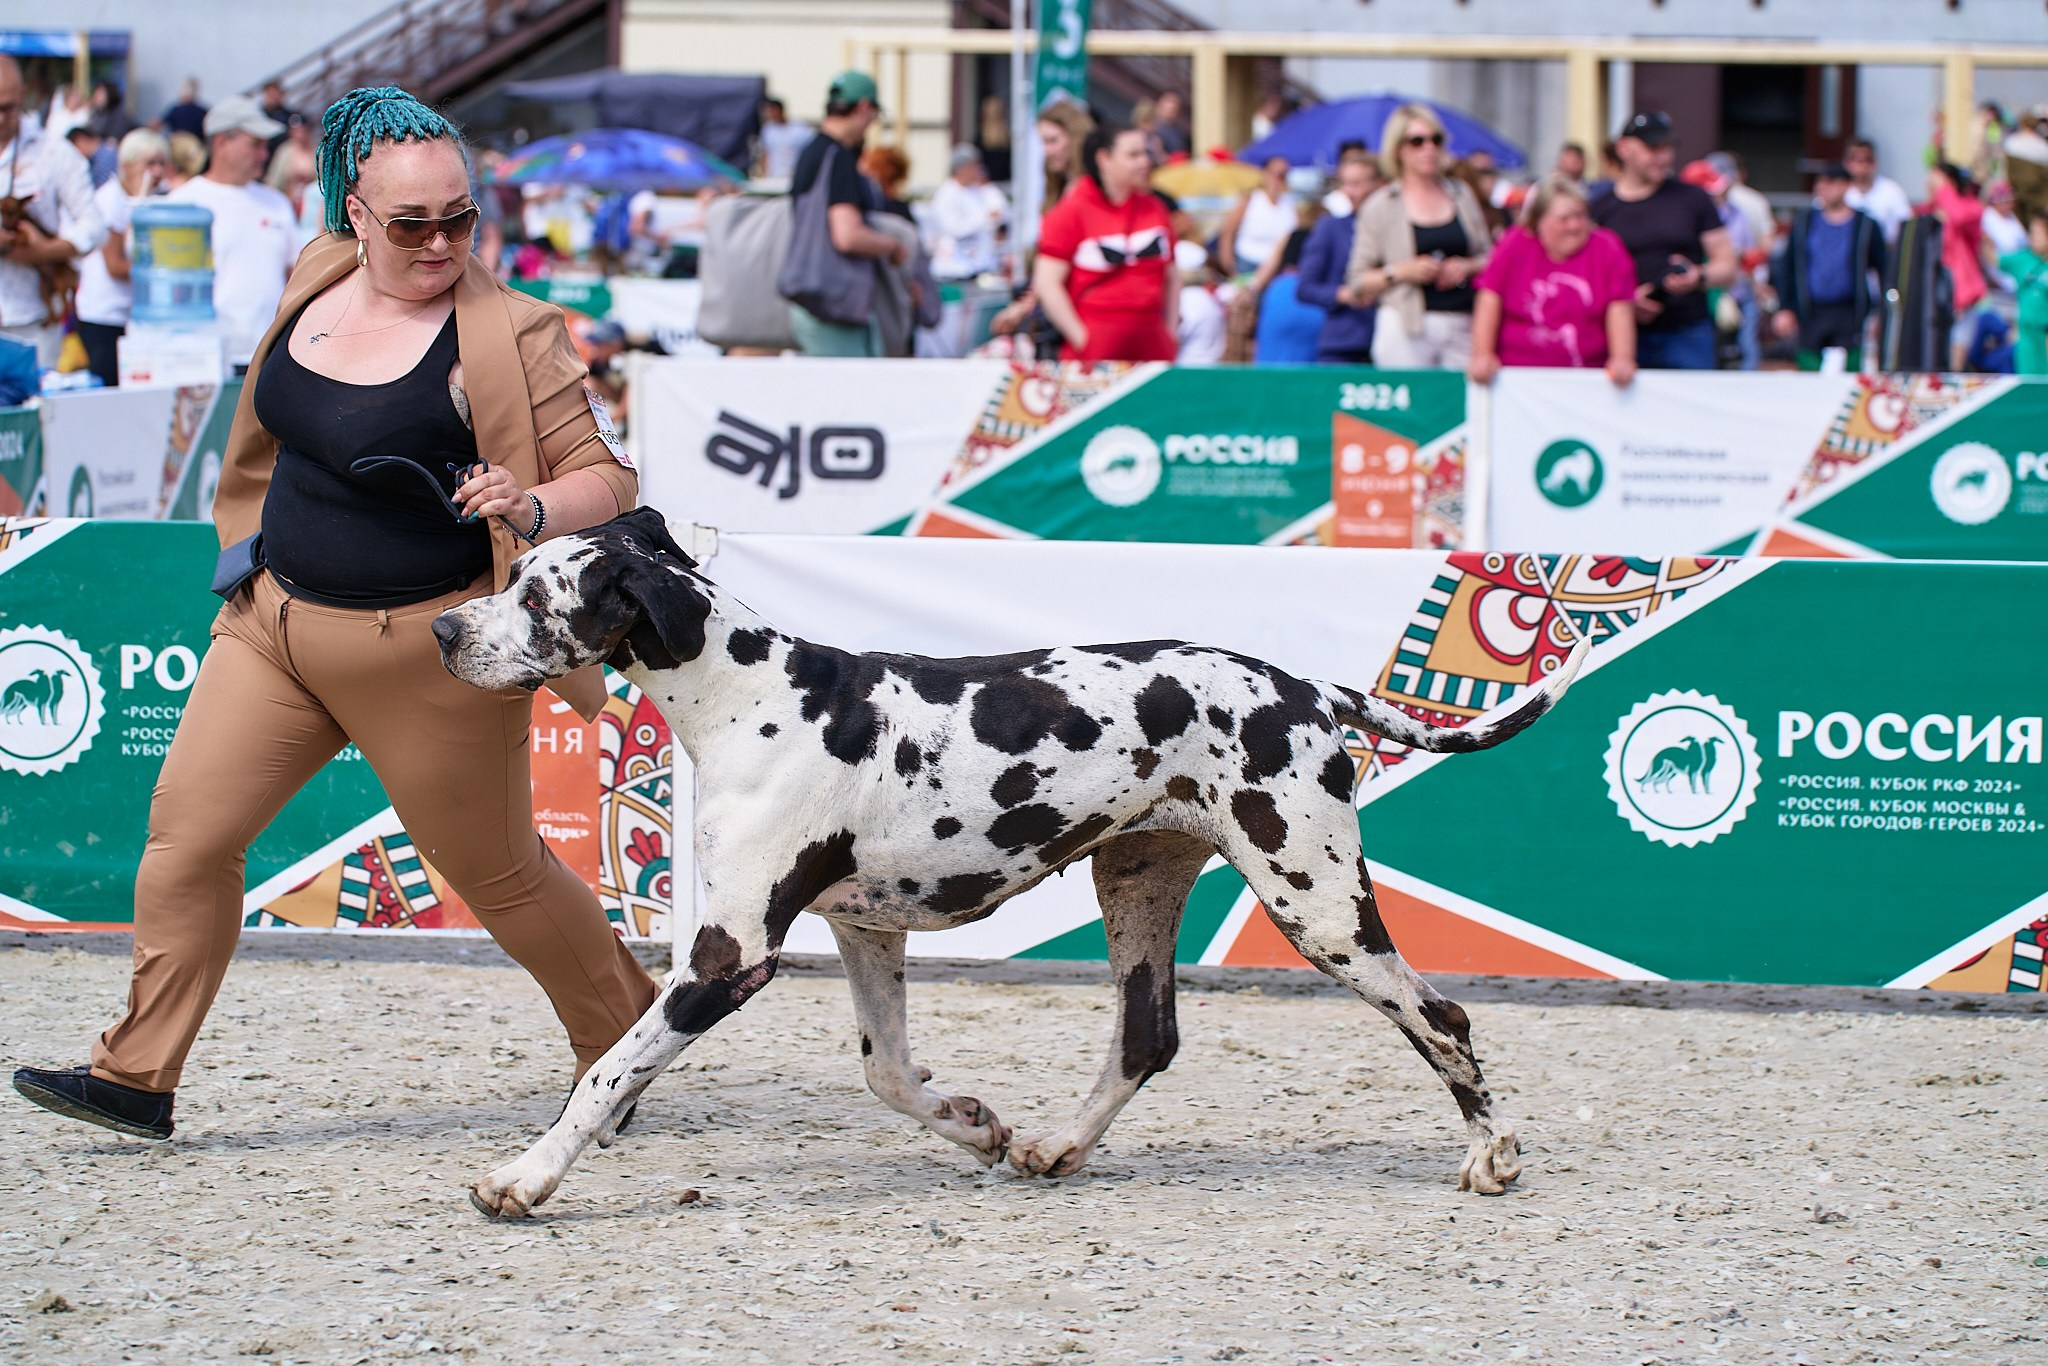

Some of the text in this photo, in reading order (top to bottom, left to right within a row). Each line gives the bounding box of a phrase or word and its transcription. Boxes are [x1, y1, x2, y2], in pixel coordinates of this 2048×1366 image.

[1339, 382, 1410, 411] 2024
[1778, 711, 2043, 764] РОССИЯ
[1870, 777, 1927, 791] КУБОК
[1933, 778, 1969, 792] РКФ
[1869, 799, 1927, 813] КУБОК
[1932, 801, 2009, 816] МОСКВЫ
[2014, 802, 2026, 816] &
[1778, 814, 1835, 828] КУБОК
